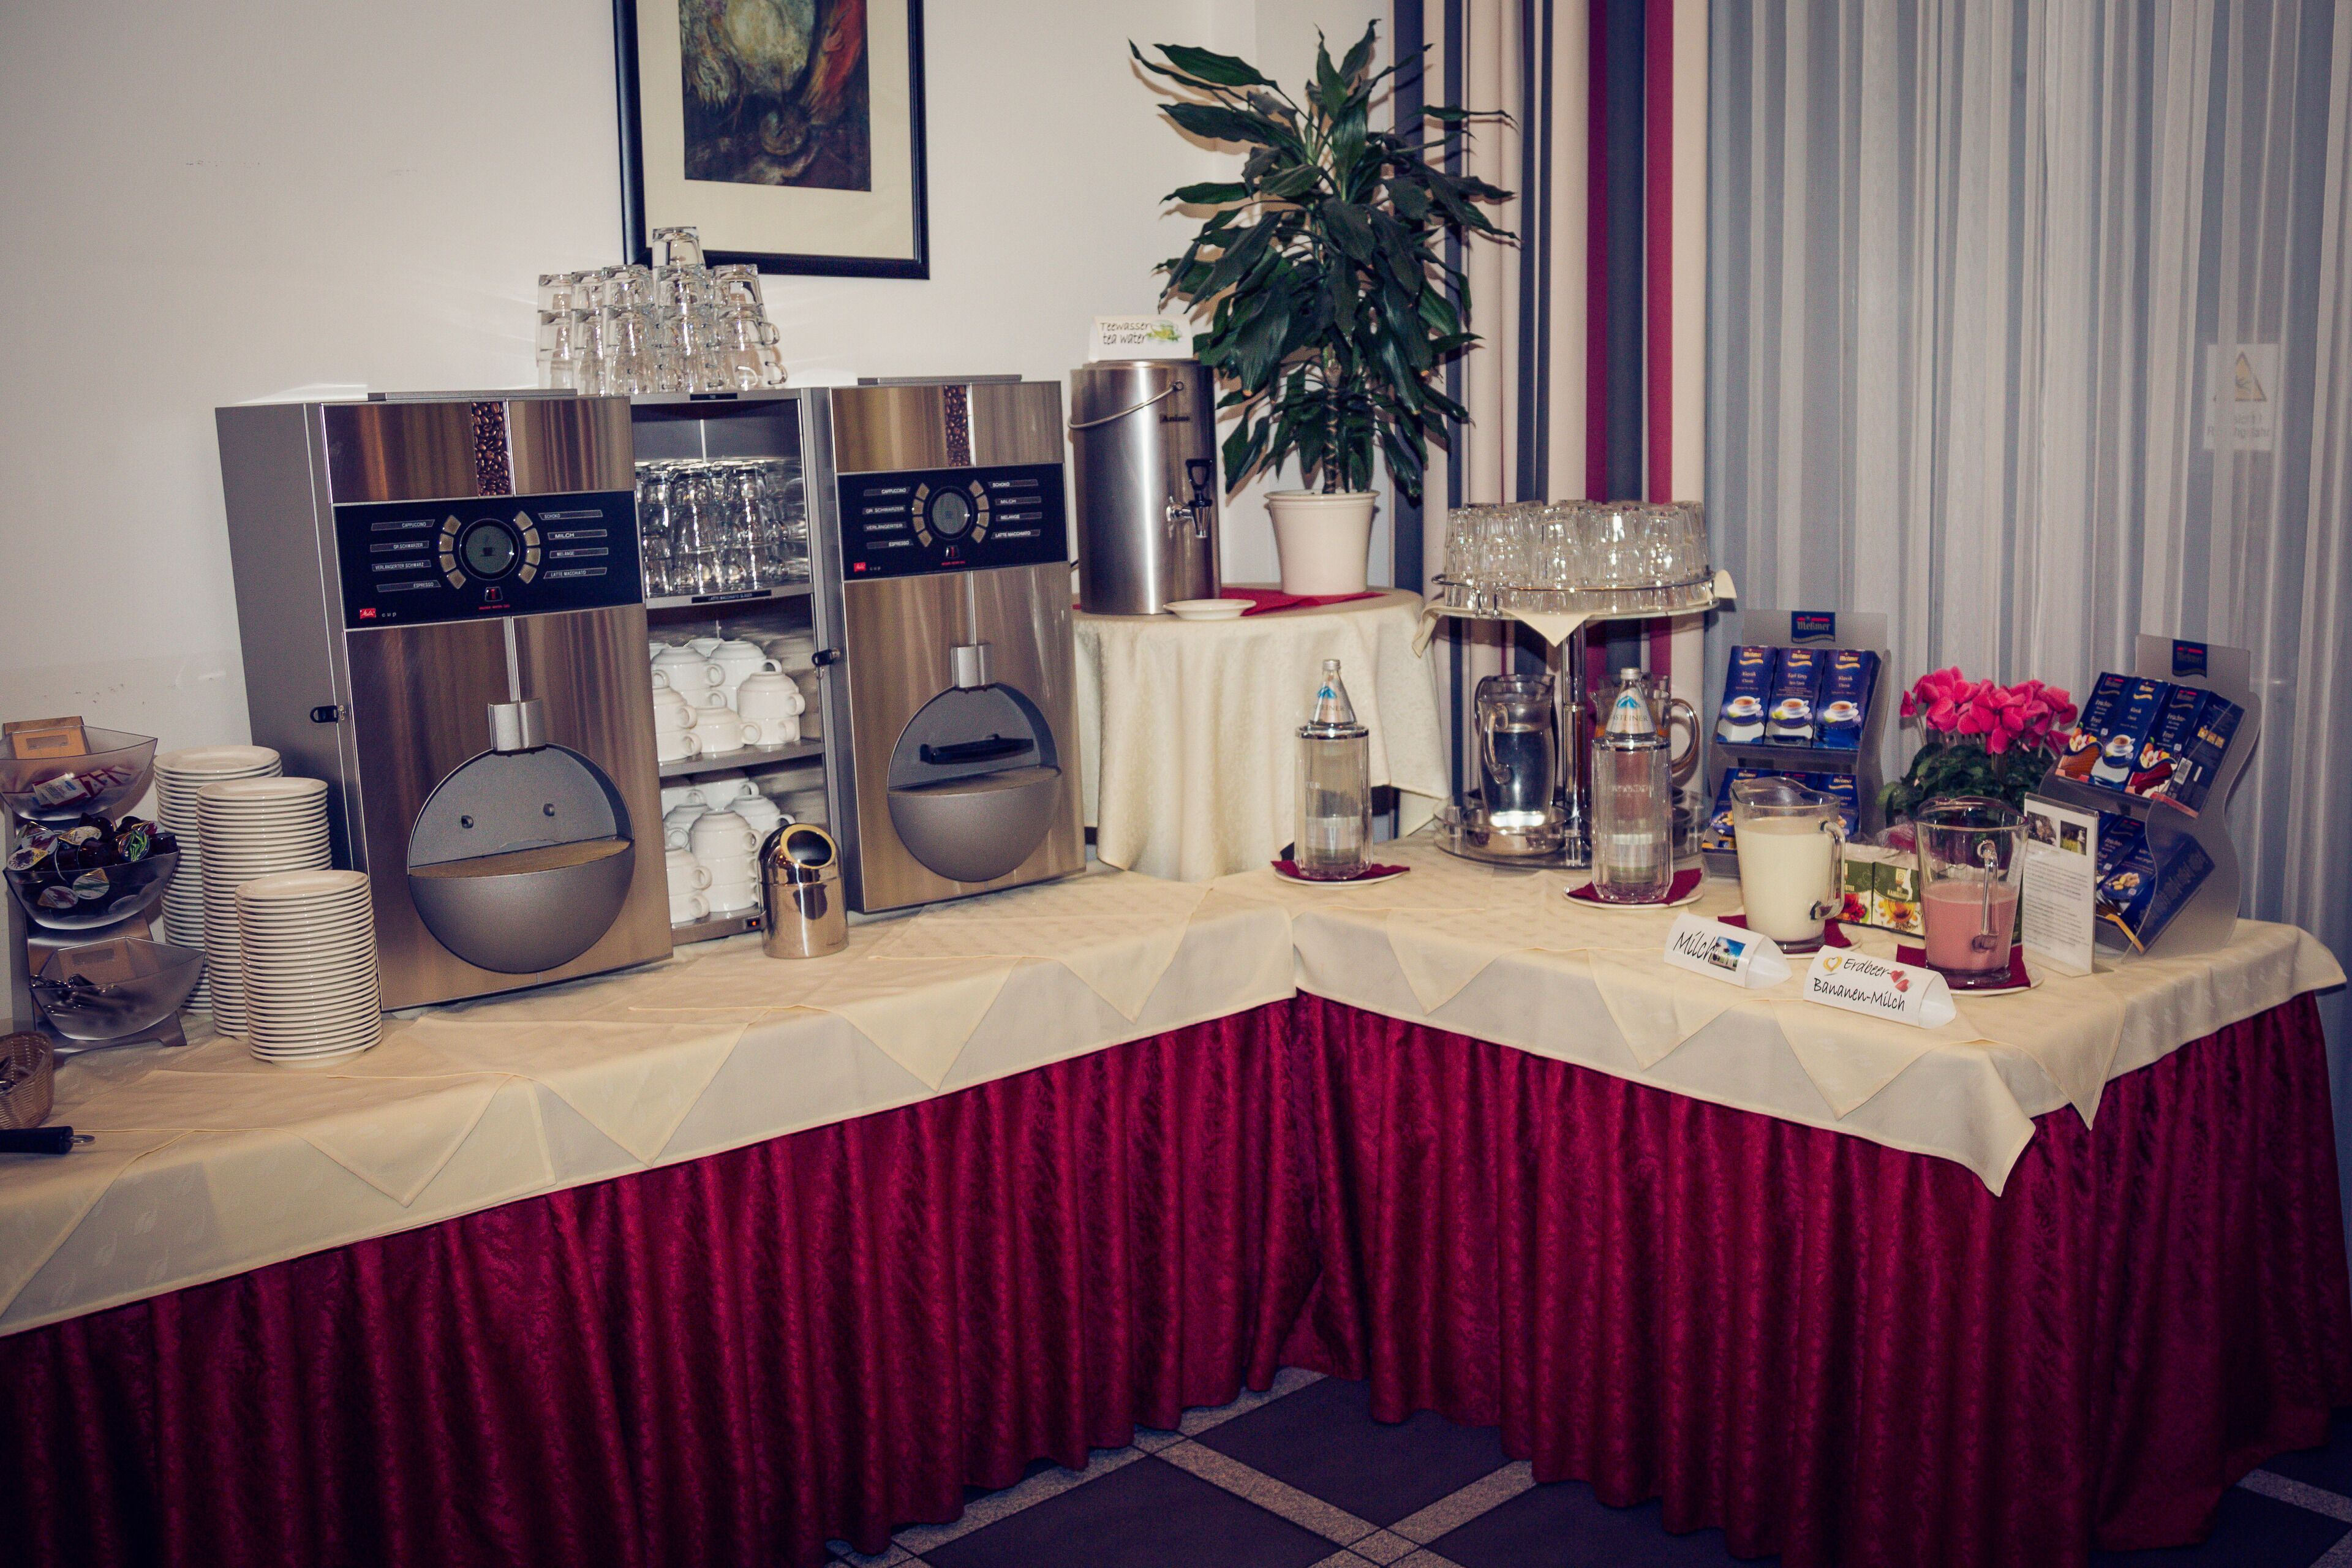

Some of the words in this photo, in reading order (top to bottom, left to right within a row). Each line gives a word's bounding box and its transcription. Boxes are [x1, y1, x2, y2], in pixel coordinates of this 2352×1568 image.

[1100, 322, 1152, 331] Teewasser
[1102, 333, 1117, 344] tea
[1120, 331, 1146, 344] water
[1673, 930, 1716, 963] Milch
[1813, 977, 1905, 1012] Bananen-Milch
